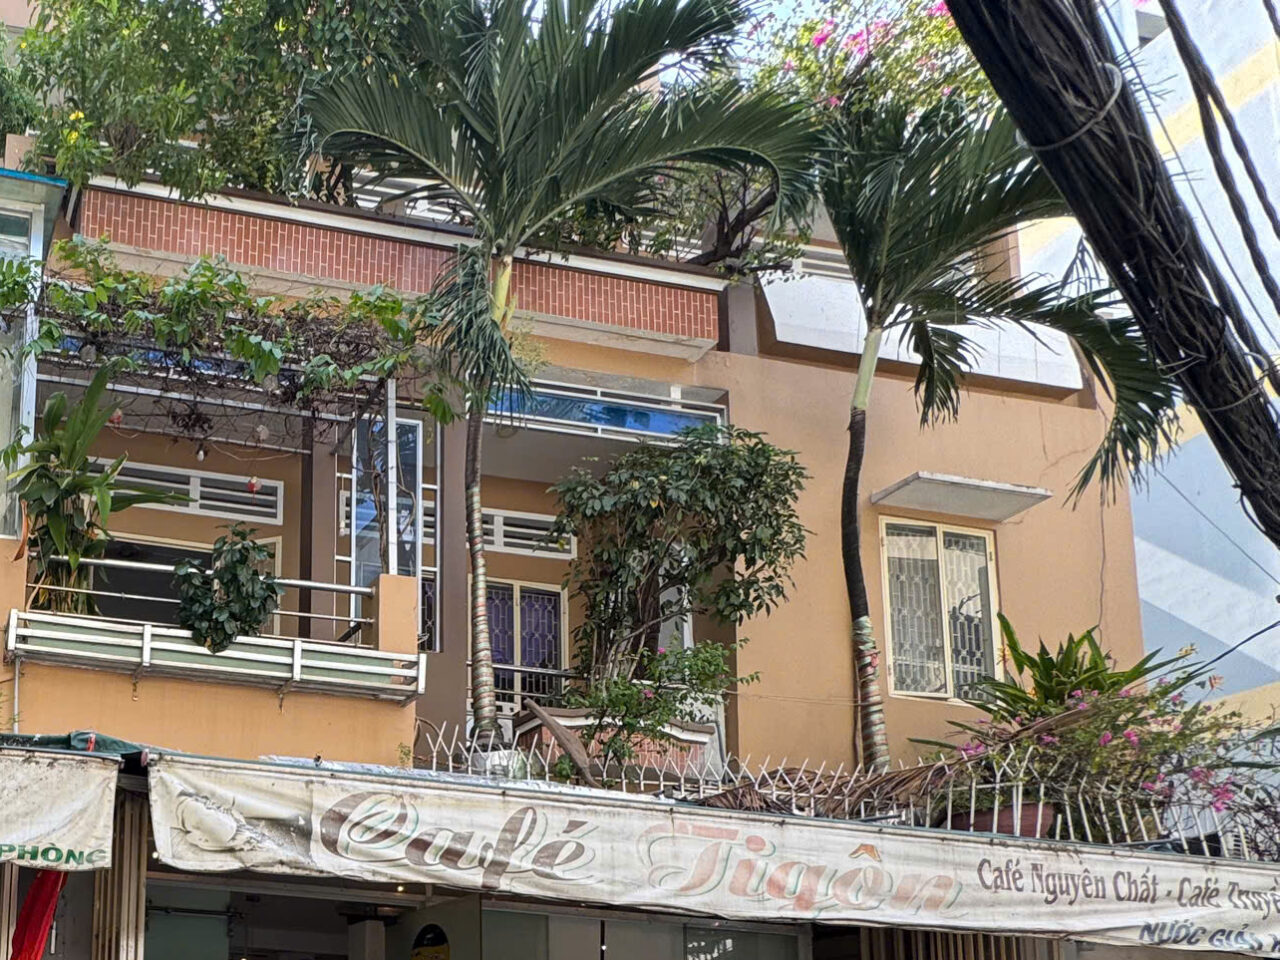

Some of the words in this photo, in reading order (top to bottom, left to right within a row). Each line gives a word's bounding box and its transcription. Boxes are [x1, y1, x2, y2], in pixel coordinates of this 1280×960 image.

[320, 790, 603, 889] Café
[637, 822, 972, 917] Tigôn
[977, 858, 1024, 893] Café
[1031, 863, 1107, 906] Nguyên
[1113, 866, 1159, 904] Chất
[1177, 877, 1222, 907] Café
